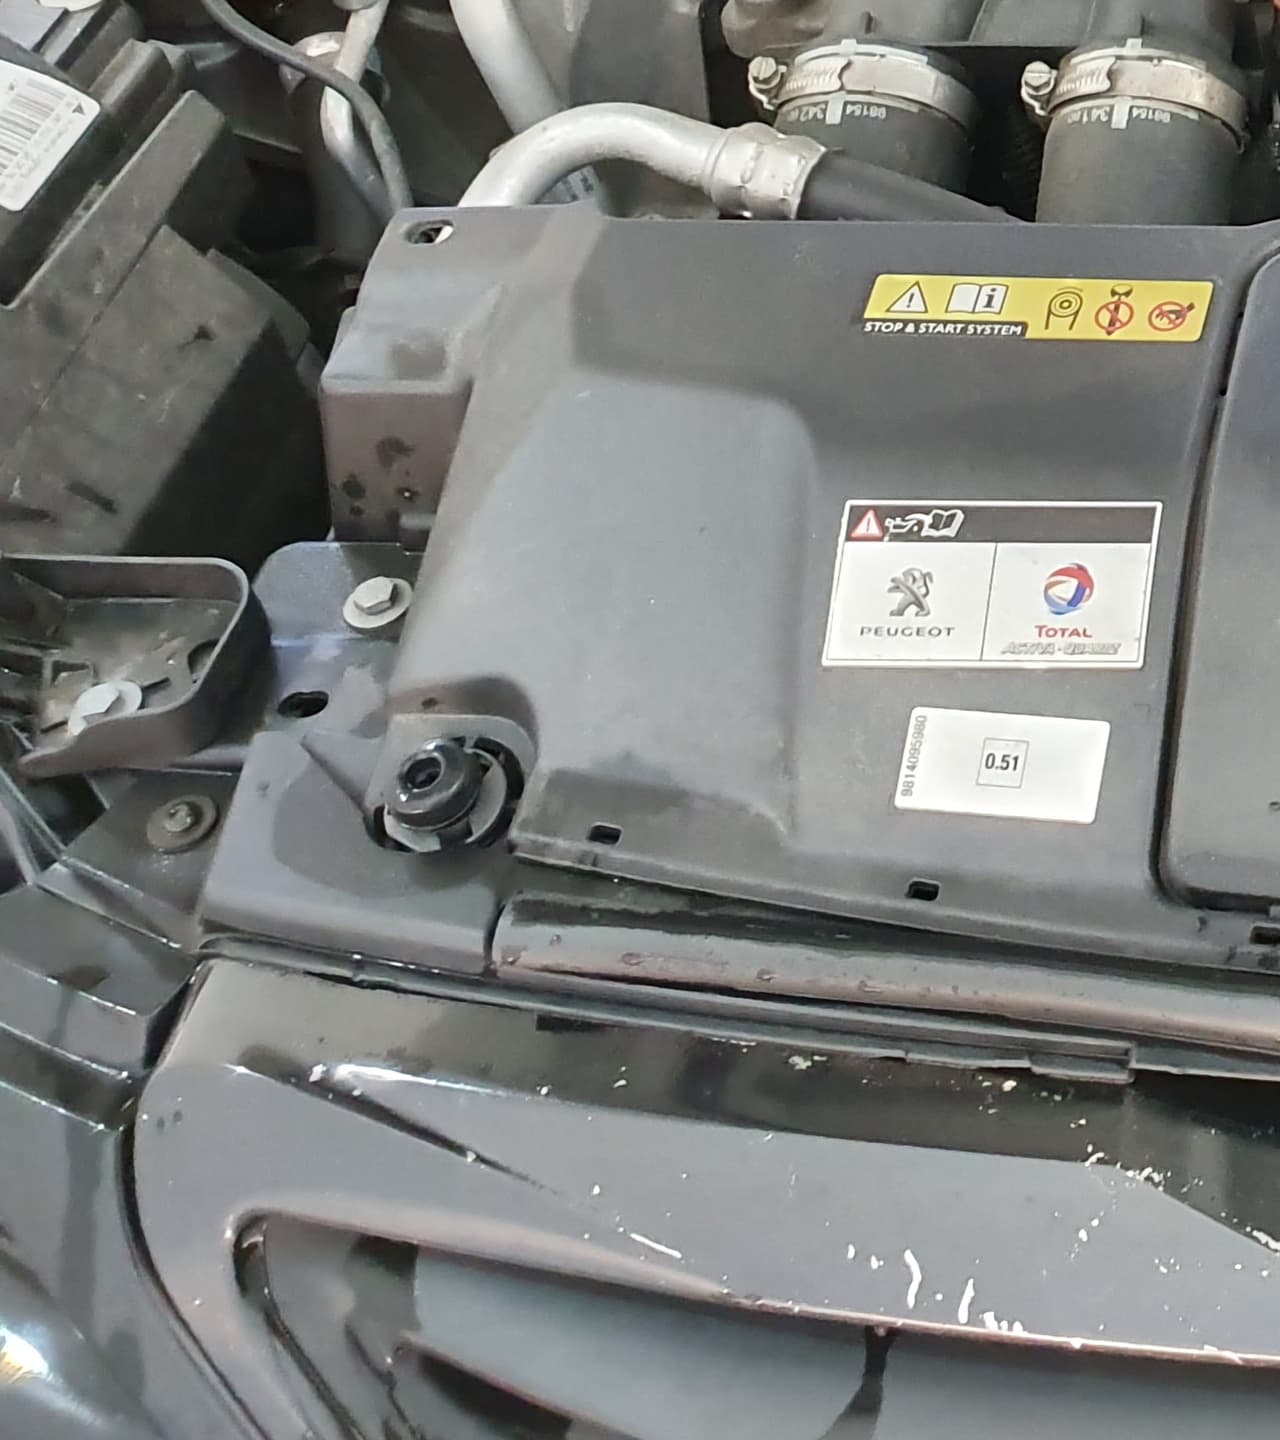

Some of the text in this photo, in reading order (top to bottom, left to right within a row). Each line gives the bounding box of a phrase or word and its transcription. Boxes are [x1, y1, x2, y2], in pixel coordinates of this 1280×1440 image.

[864, 321, 903, 333] STOP
[918, 323, 965, 334] START
[967, 324, 1022, 336] SYSTEM
[860, 626, 955, 638] PEUGEOT
[1035, 624, 1093, 638] TOTAL
[984, 752, 1020, 772] 0.51
